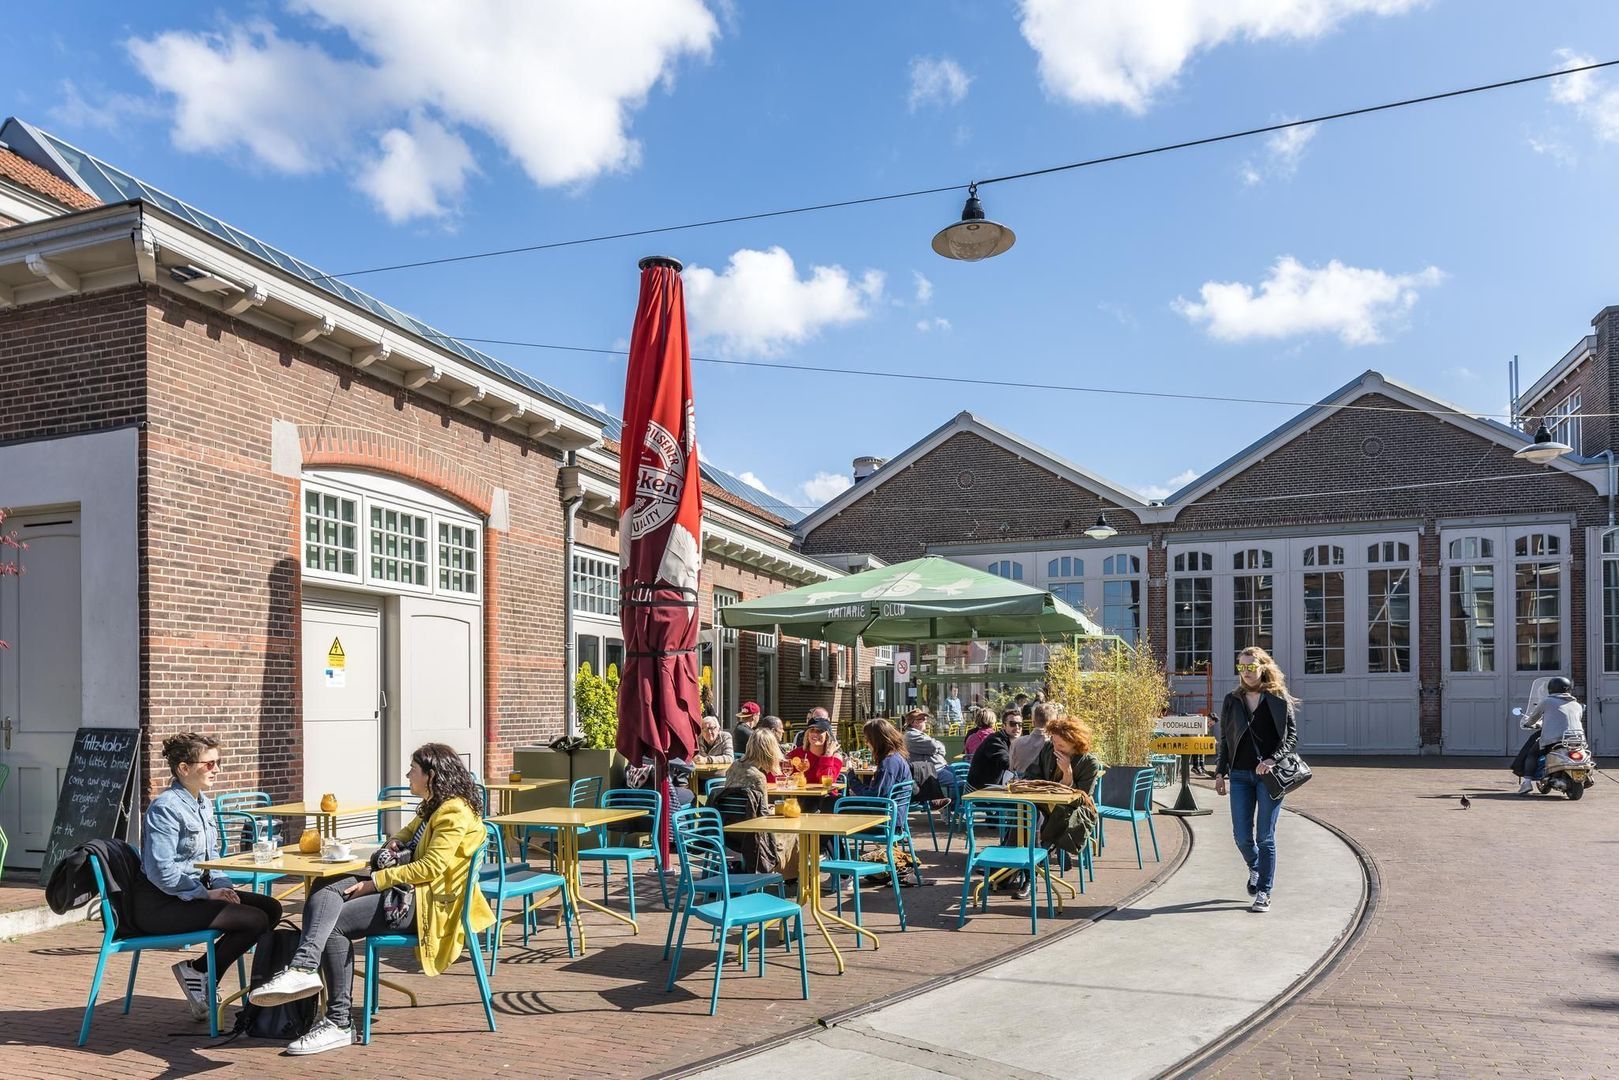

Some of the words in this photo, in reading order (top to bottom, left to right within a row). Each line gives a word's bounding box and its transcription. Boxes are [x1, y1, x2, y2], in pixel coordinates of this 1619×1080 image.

[636, 470, 678, 498] ken
[1162, 721, 1203, 729] FOODHALLEN
[89, 754, 107, 769] little
[99, 778, 111, 793] get
[80, 815, 97, 828] lunch
[64, 822, 75, 837] the
